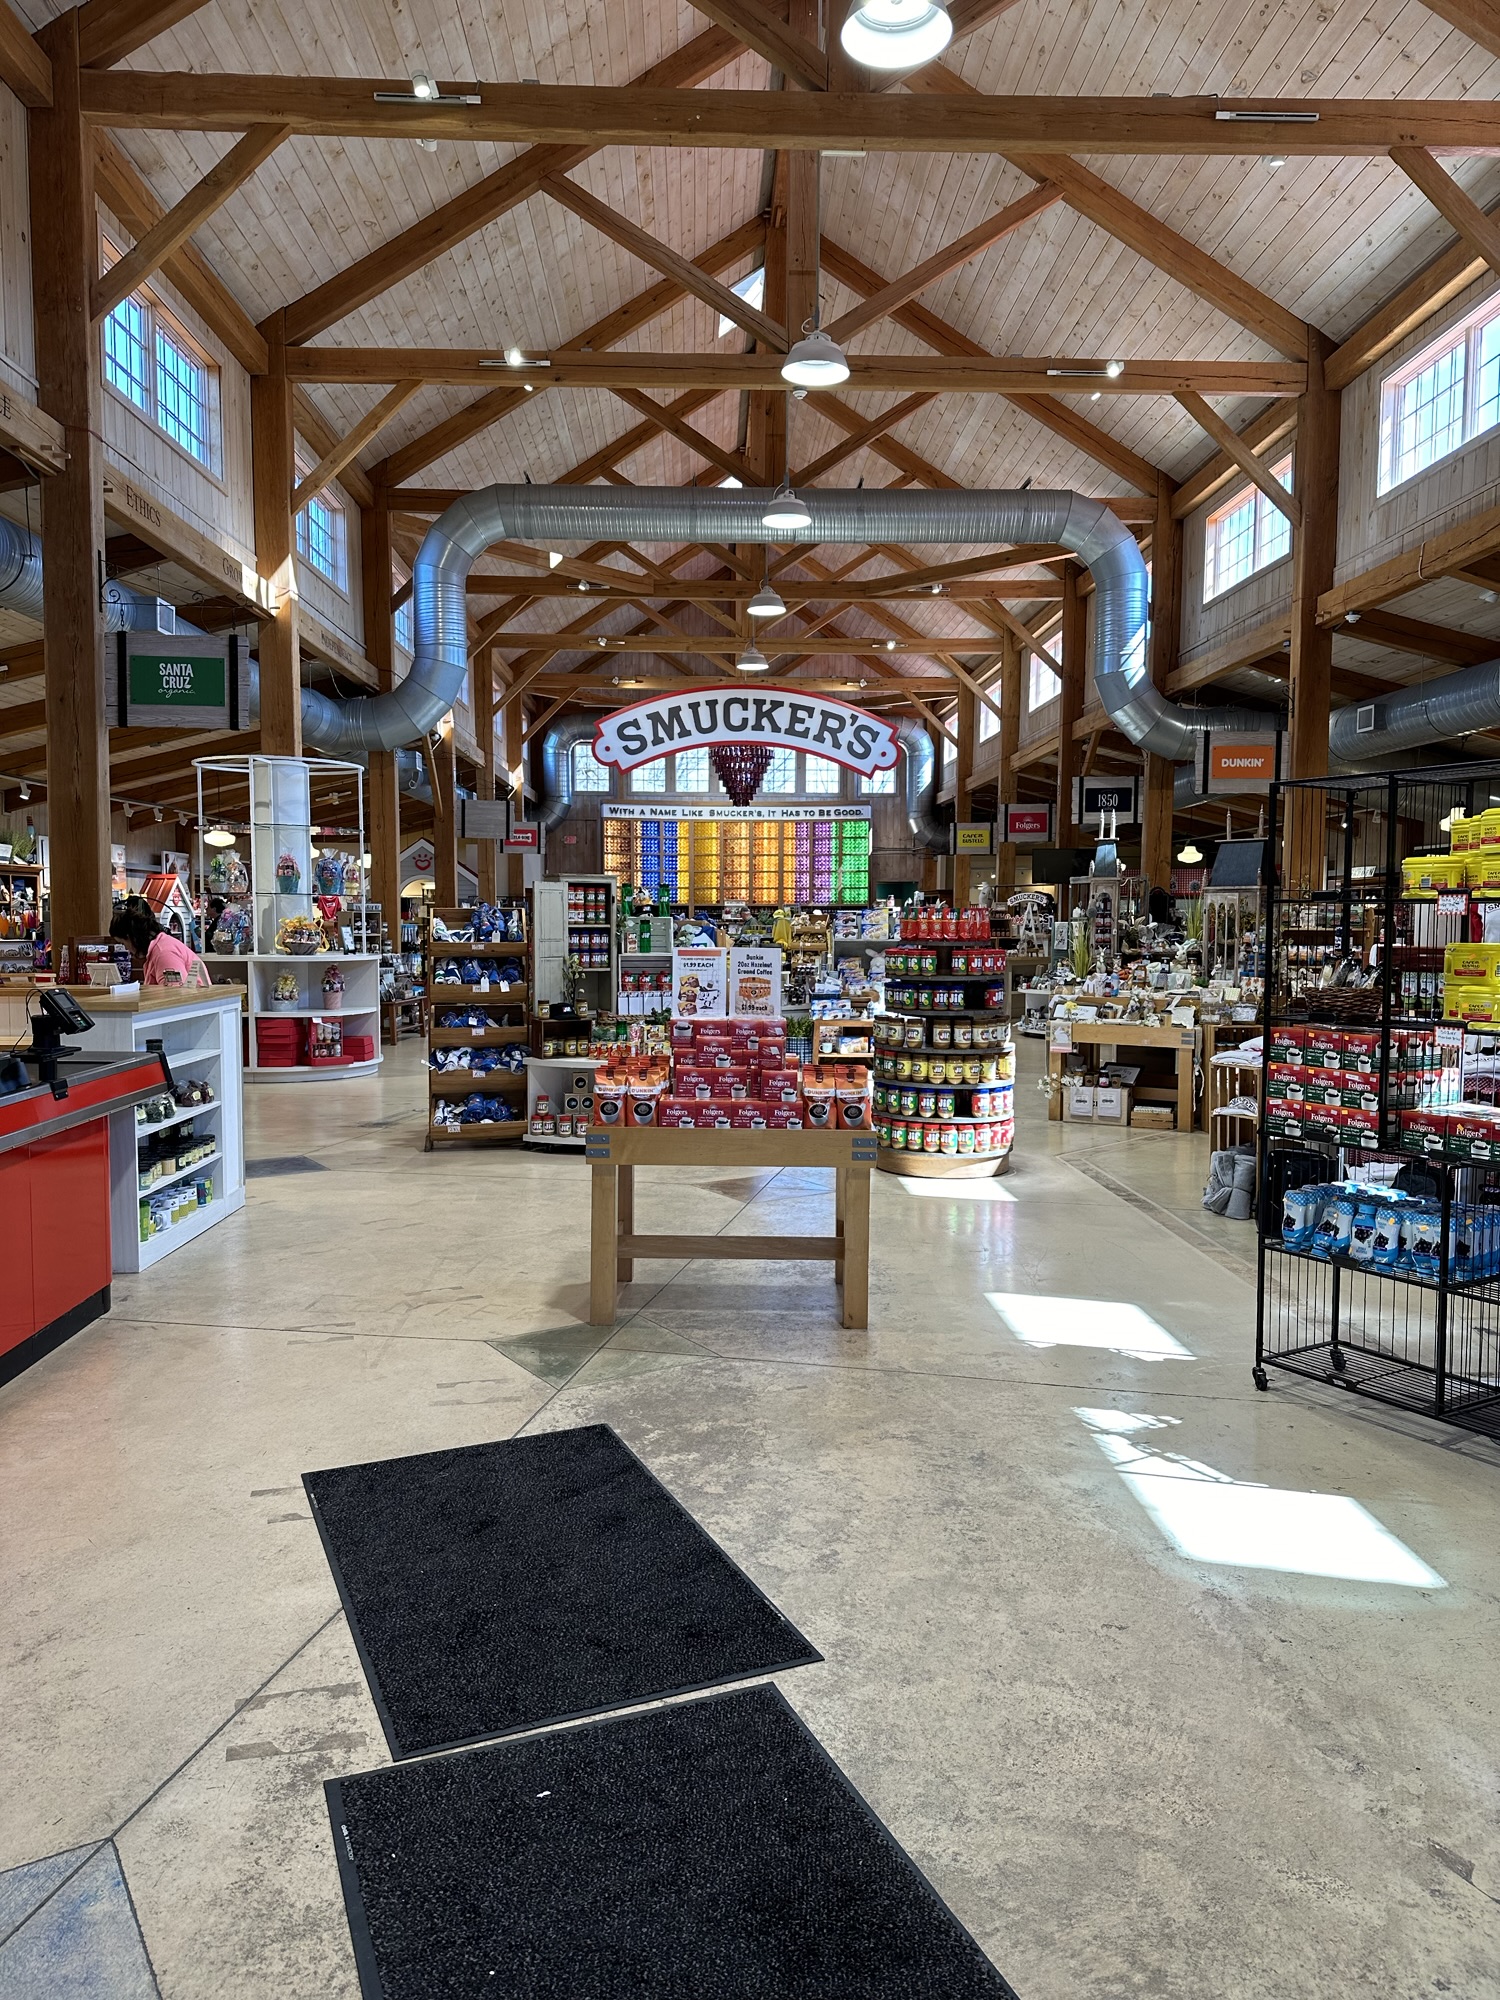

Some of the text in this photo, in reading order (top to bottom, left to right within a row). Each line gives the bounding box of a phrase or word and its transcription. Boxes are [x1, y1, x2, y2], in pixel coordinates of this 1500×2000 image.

[126, 484, 160, 528] ETHICS
[159, 662, 194, 678] SANTA
[162, 676, 192, 688] CRUZ
[158, 688, 195, 698] organic
[616, 697, 880, 760] SMUCKER'S
[1221, 758, 1264, 768] DUNKIN'
[1098, 794, 1118, 807] 1850
[609, 806, 634, 816] WITH
[650, 808, 677, 816] NAME
[709, 809, 764, 818] SMUCKER'S,
[1016, 822, 1040, 830] Folgers
[1275, 1037, 1296, 1046] Folgers
[1312, 1040, 1333, 1049] Folgers
[1274, 1073, 1296, 1082] Folgers
[1312, 1078, 1334, 1086] Folgers
[1348, 1082, 1370, 1091] Folgers
[1272, 1108, 1294, 1117] Folgers
[1311, 1113, 1333, 1123] Folgers
[1348, 1119, 1371, 1128] Folgers
[1410, 1122, 1435, 1132] Folgers
[1456, 1128, 1482, 1138] Folgers
